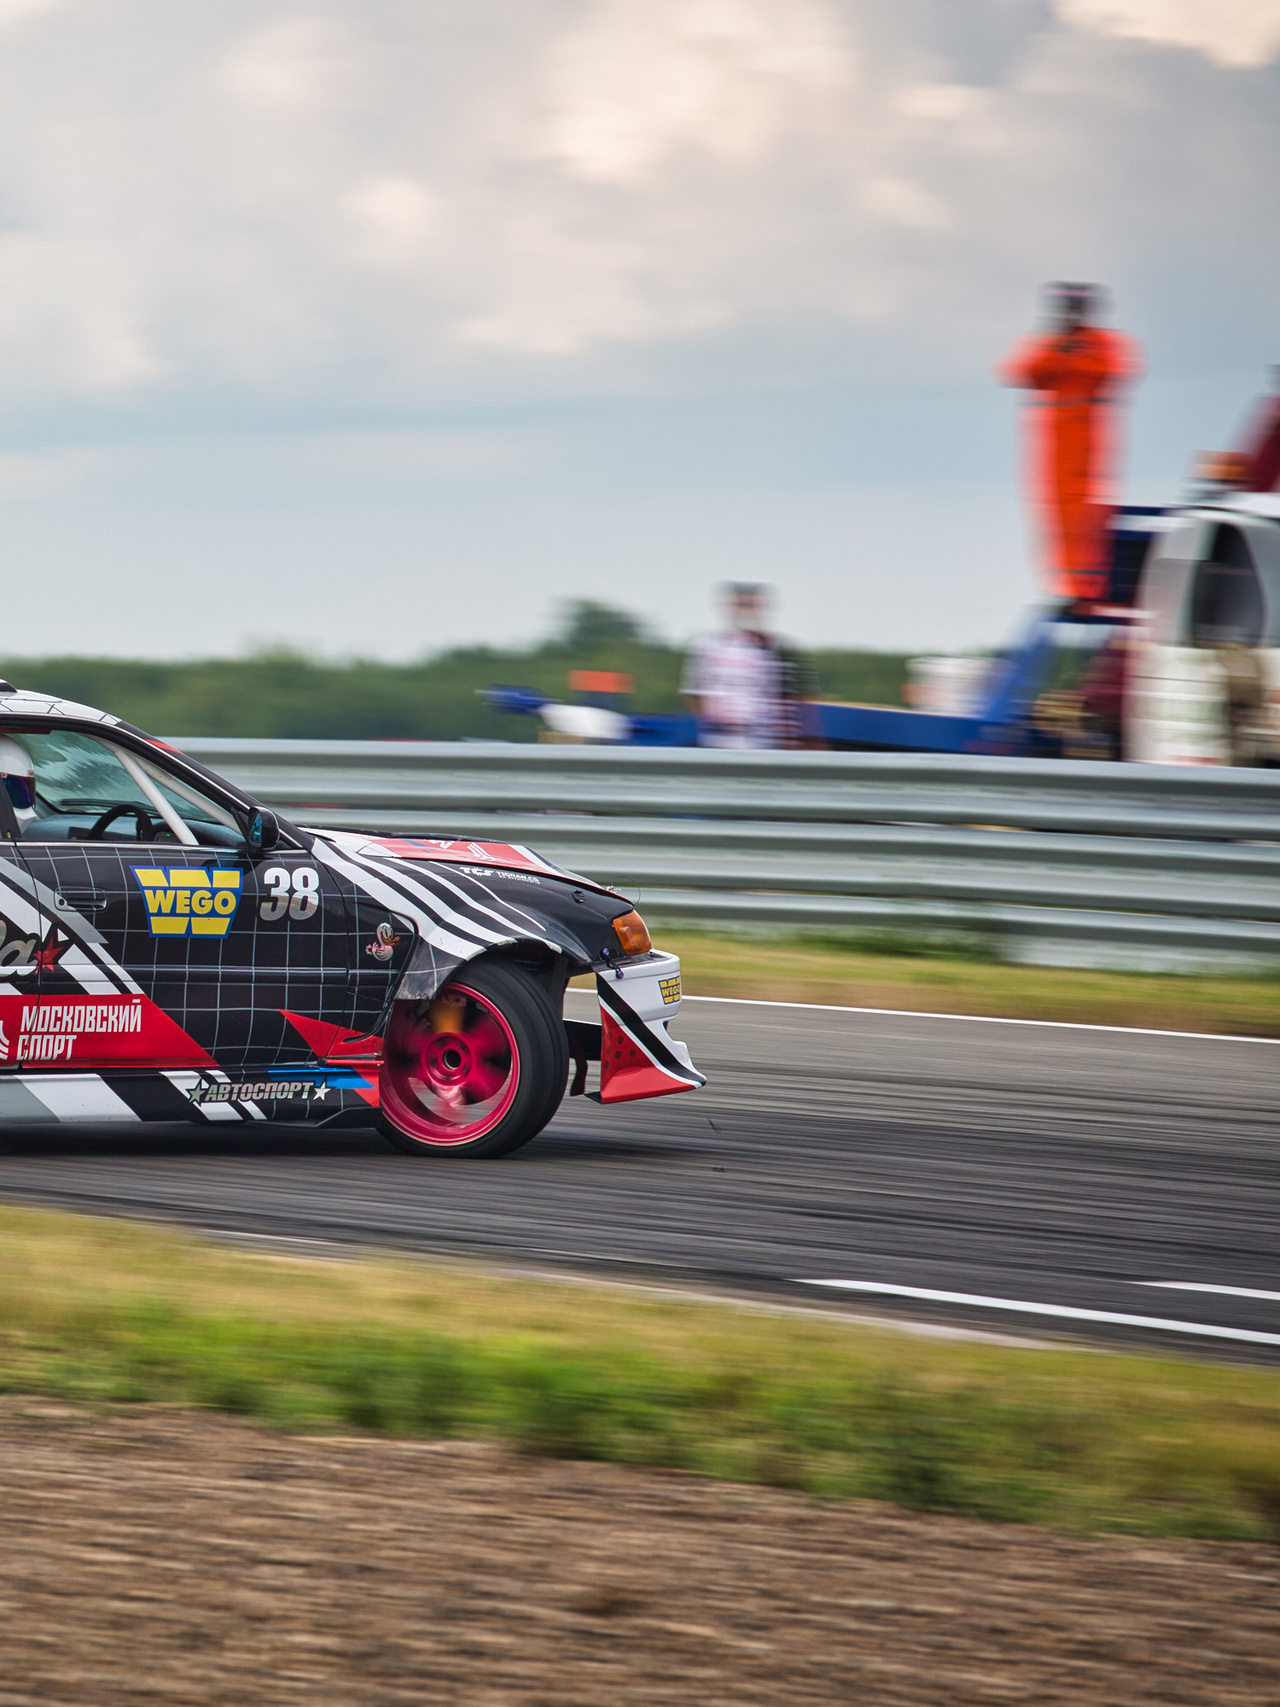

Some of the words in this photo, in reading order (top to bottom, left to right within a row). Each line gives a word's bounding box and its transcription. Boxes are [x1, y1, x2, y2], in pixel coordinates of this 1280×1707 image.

[143, 889, 237, 915] WEGO
[260, 867, 320, 922] 38
[20, 999, 142, 1032] МОСКОВСКИЙ
[16, 1034, 77, 1061] СПОРТ
[204, 1082, 314, 1101] АВТОСПОРТ
